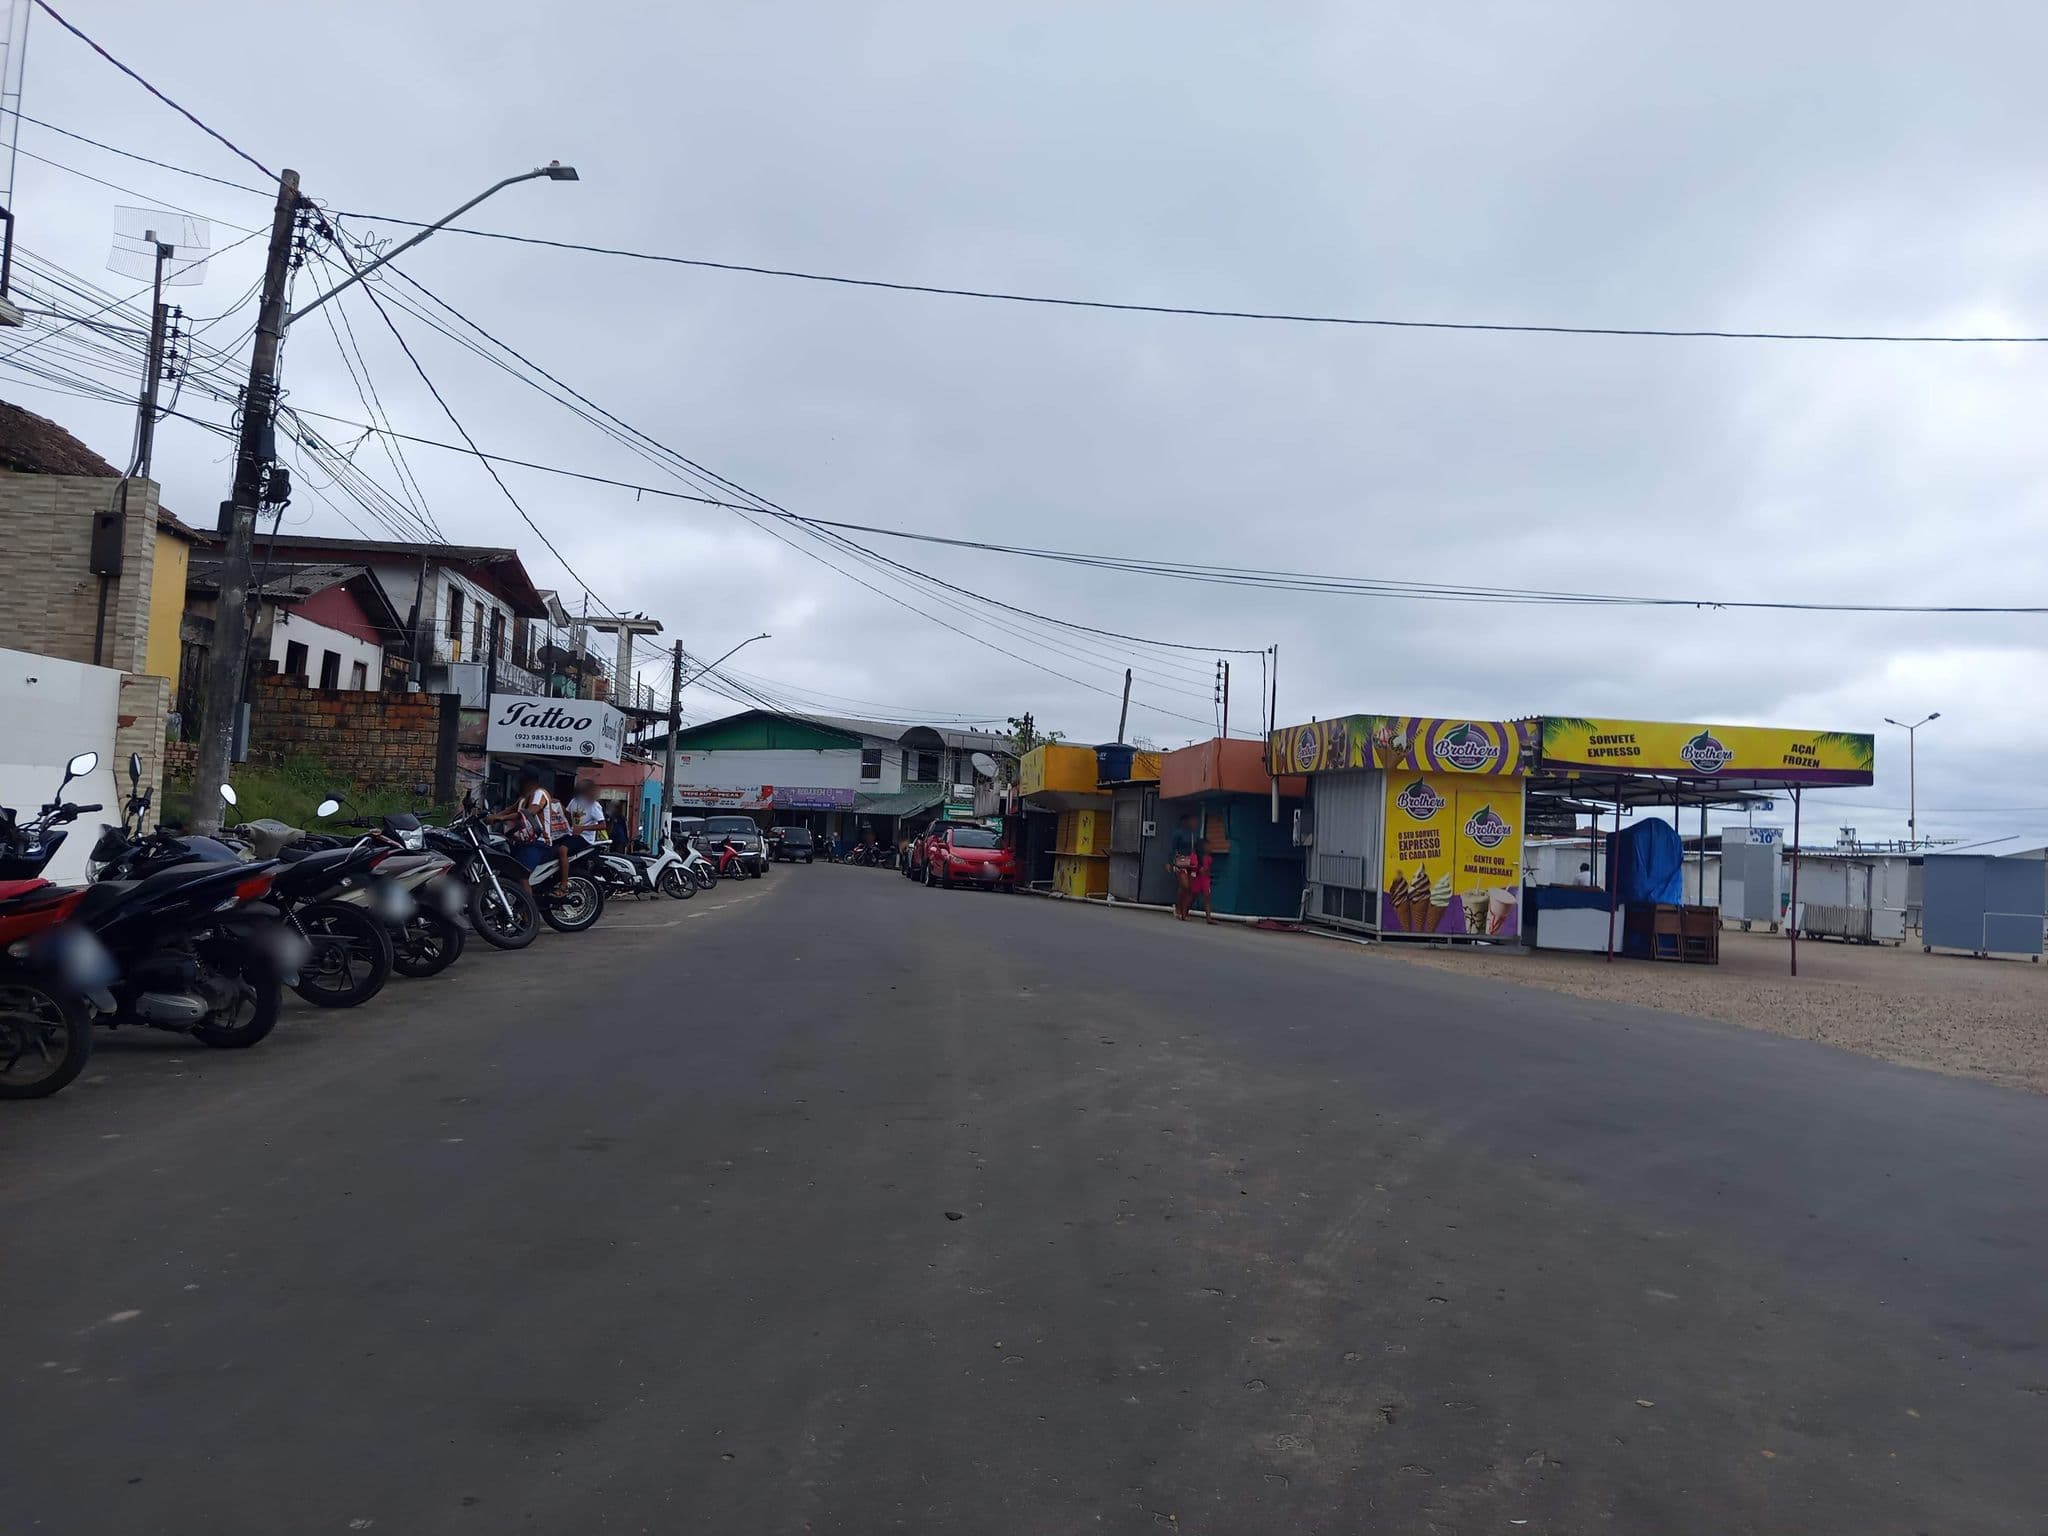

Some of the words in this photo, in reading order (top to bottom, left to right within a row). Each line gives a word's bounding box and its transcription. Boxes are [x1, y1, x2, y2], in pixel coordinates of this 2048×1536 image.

[498, 702, 592, 730] Tattoo
[514, 733, 530, 741] (92)
[1589, 734, 1636, 745] SORVETE
[1434, 739, 1499, 758] Brothers
[1587, 746, 1641, 758] EXPRESSO
[1680, 744, 1733, 761] Brothers
[1782, 754, 1820, 769] FROZEN
[1397, 792, 1445, 809] Brothers
[1403, 831, 1415, 839] SEU
[1415, 829, 1440, 838] SORVETE
[1464, 819, 1512, 837] Brothers
[1399, 838, 1440, 851] EXPRESSO
[1400, 852, 1408, 861] DE
[1409, 850, 1427, 860] CADA
[1473, 854, 1492, 864] GENTE
[1493, 856, 1505, 865] QUE
[1463, 864, 1478, 873] AMA
[1478, 866, 1513, 878] MILKSHAKE
